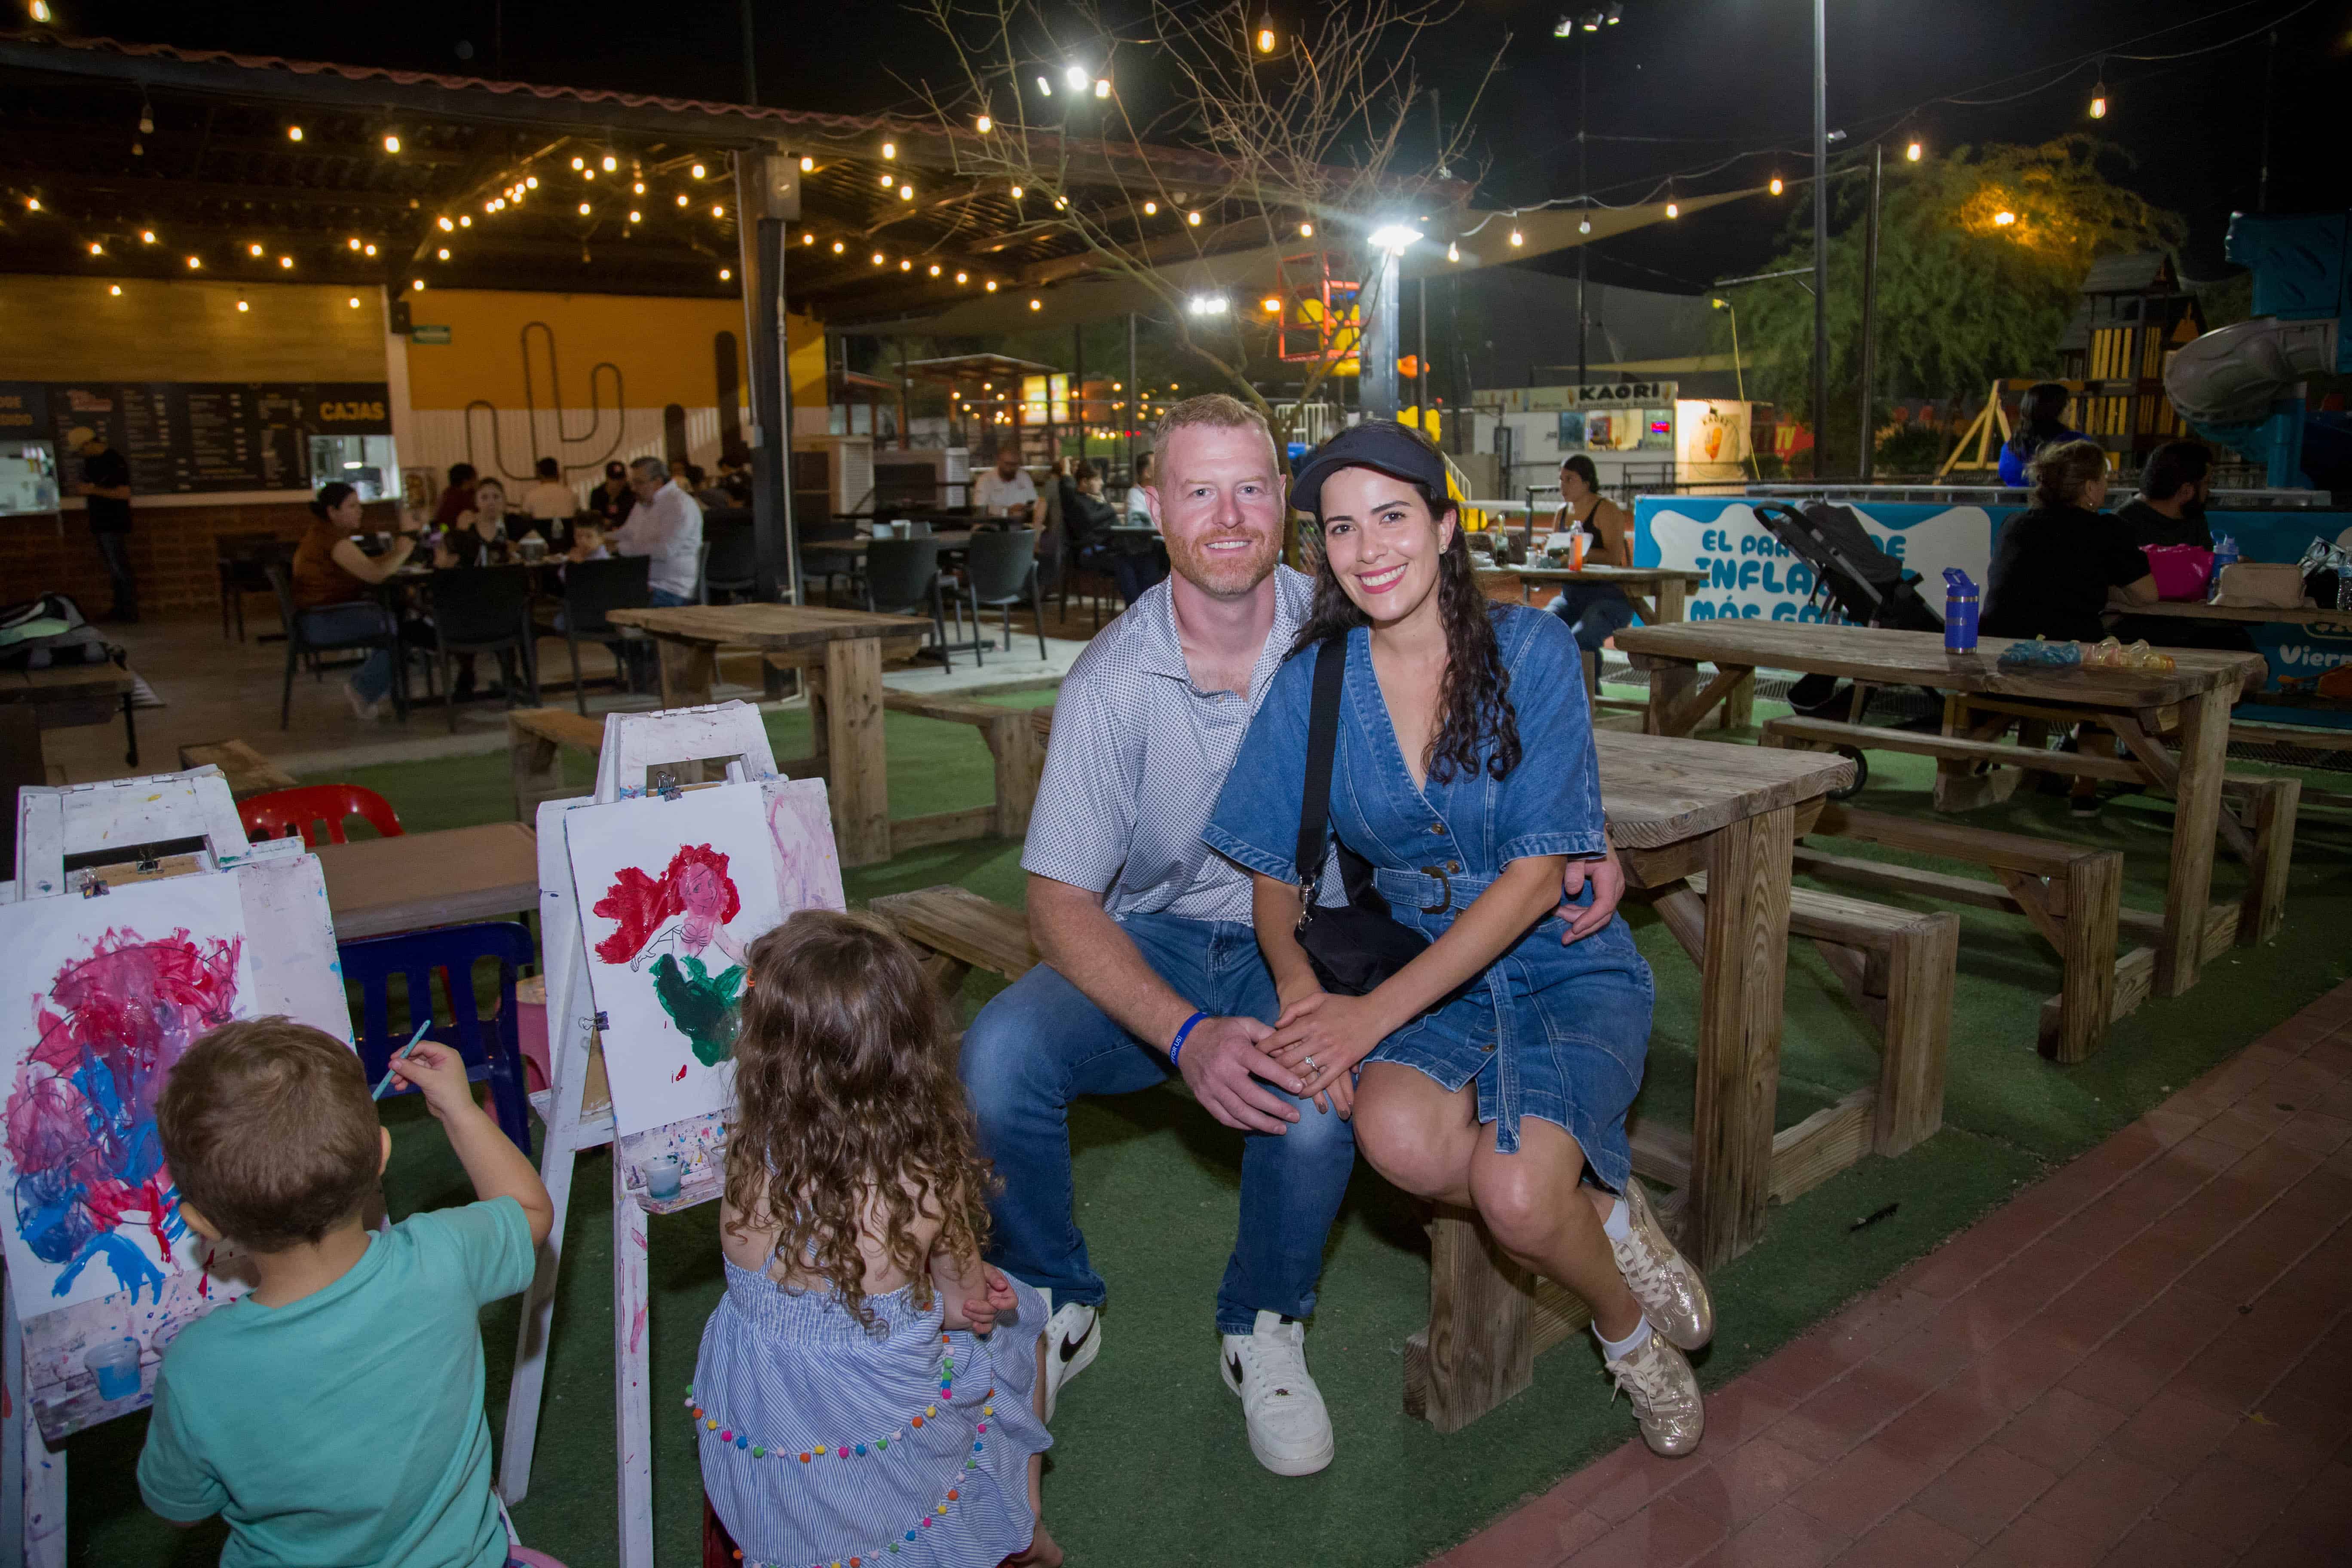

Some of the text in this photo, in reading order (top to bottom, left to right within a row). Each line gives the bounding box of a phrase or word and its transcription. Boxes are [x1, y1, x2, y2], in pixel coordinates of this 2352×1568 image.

[1579, 382, 1660, 401] KAORI
[320, 401, 385, 421] CAJAS
[1702, 530, 1733, 551] EL
[1741, 535, 1790, 558] PAR
[1695, 557, 1829, 596] INFLA
[1691, 595, 1761, 622] MÁS
[1174, 1035, 1183, 1046] US!
